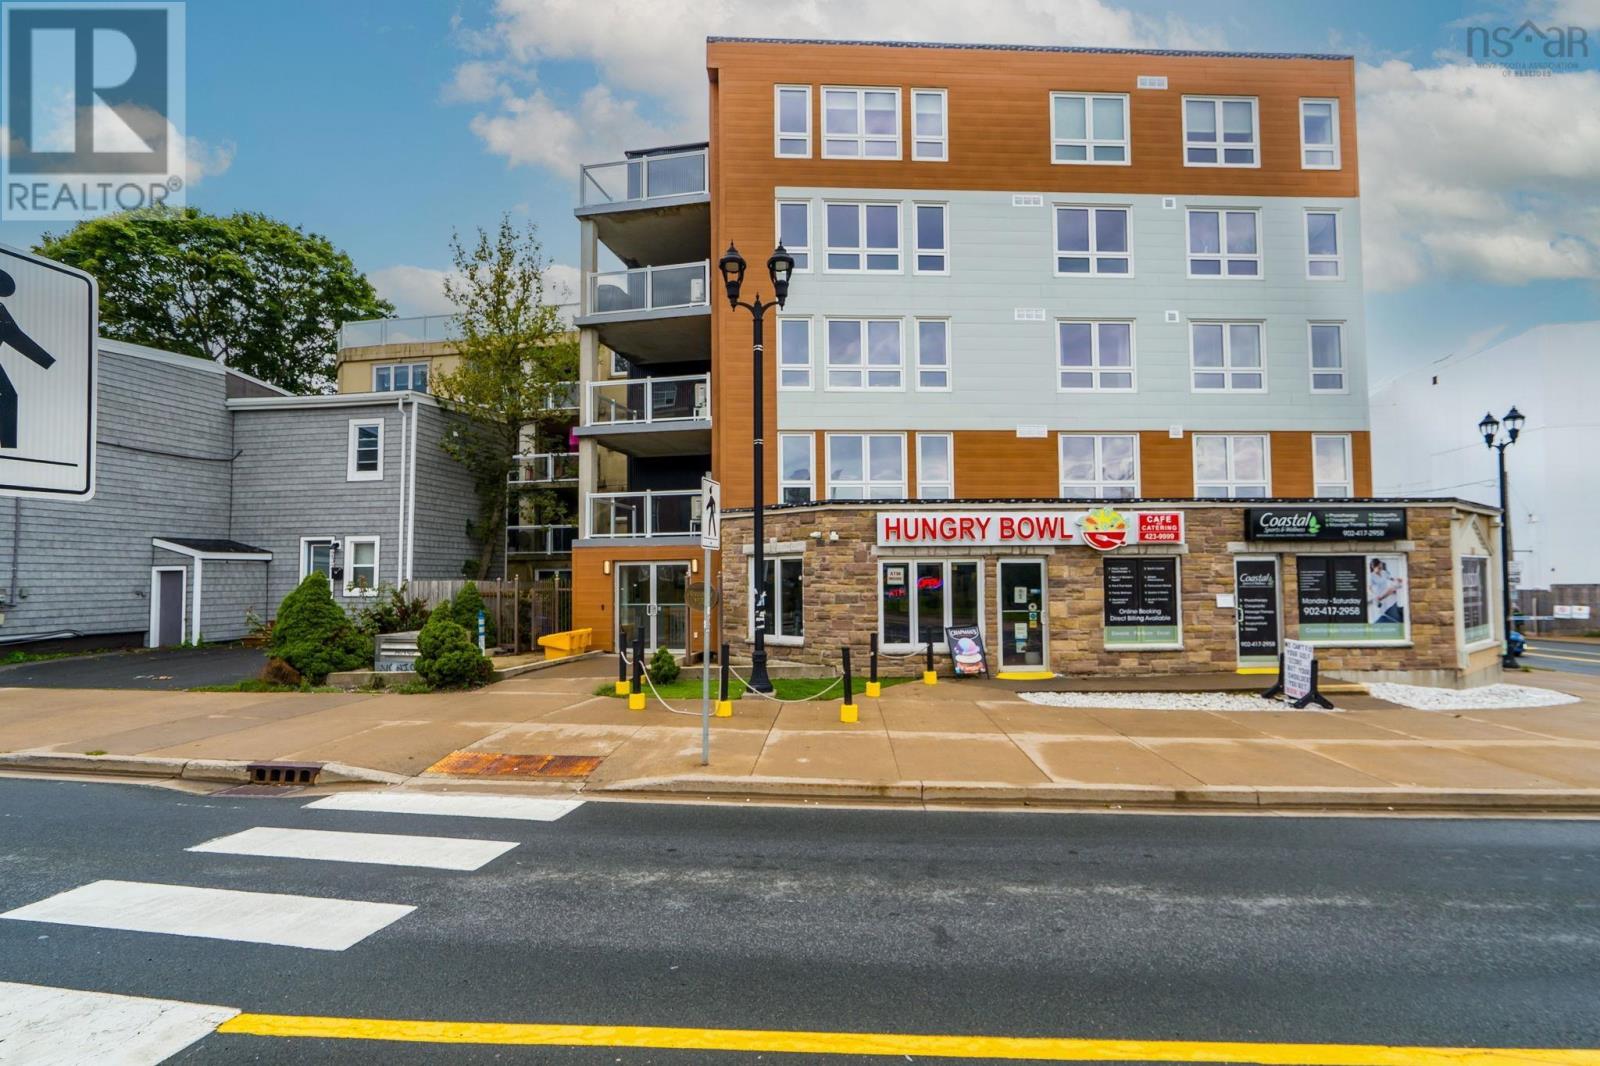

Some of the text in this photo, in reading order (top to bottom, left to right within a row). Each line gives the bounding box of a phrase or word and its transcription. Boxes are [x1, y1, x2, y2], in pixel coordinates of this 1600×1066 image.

[1146, 515, 1172, 523] CAFE
[1259, 512, 1312, 527] Coastal
[885, 516, 1073, 542] HUNGRY BOWL
[1239, 573, 1271, 582] Coastal
[1302, 598, 1329, 606] Monday
[1332, 596, 1362, 605] Saturday
[1303, 607, 1361, 616] 902-417-2958
